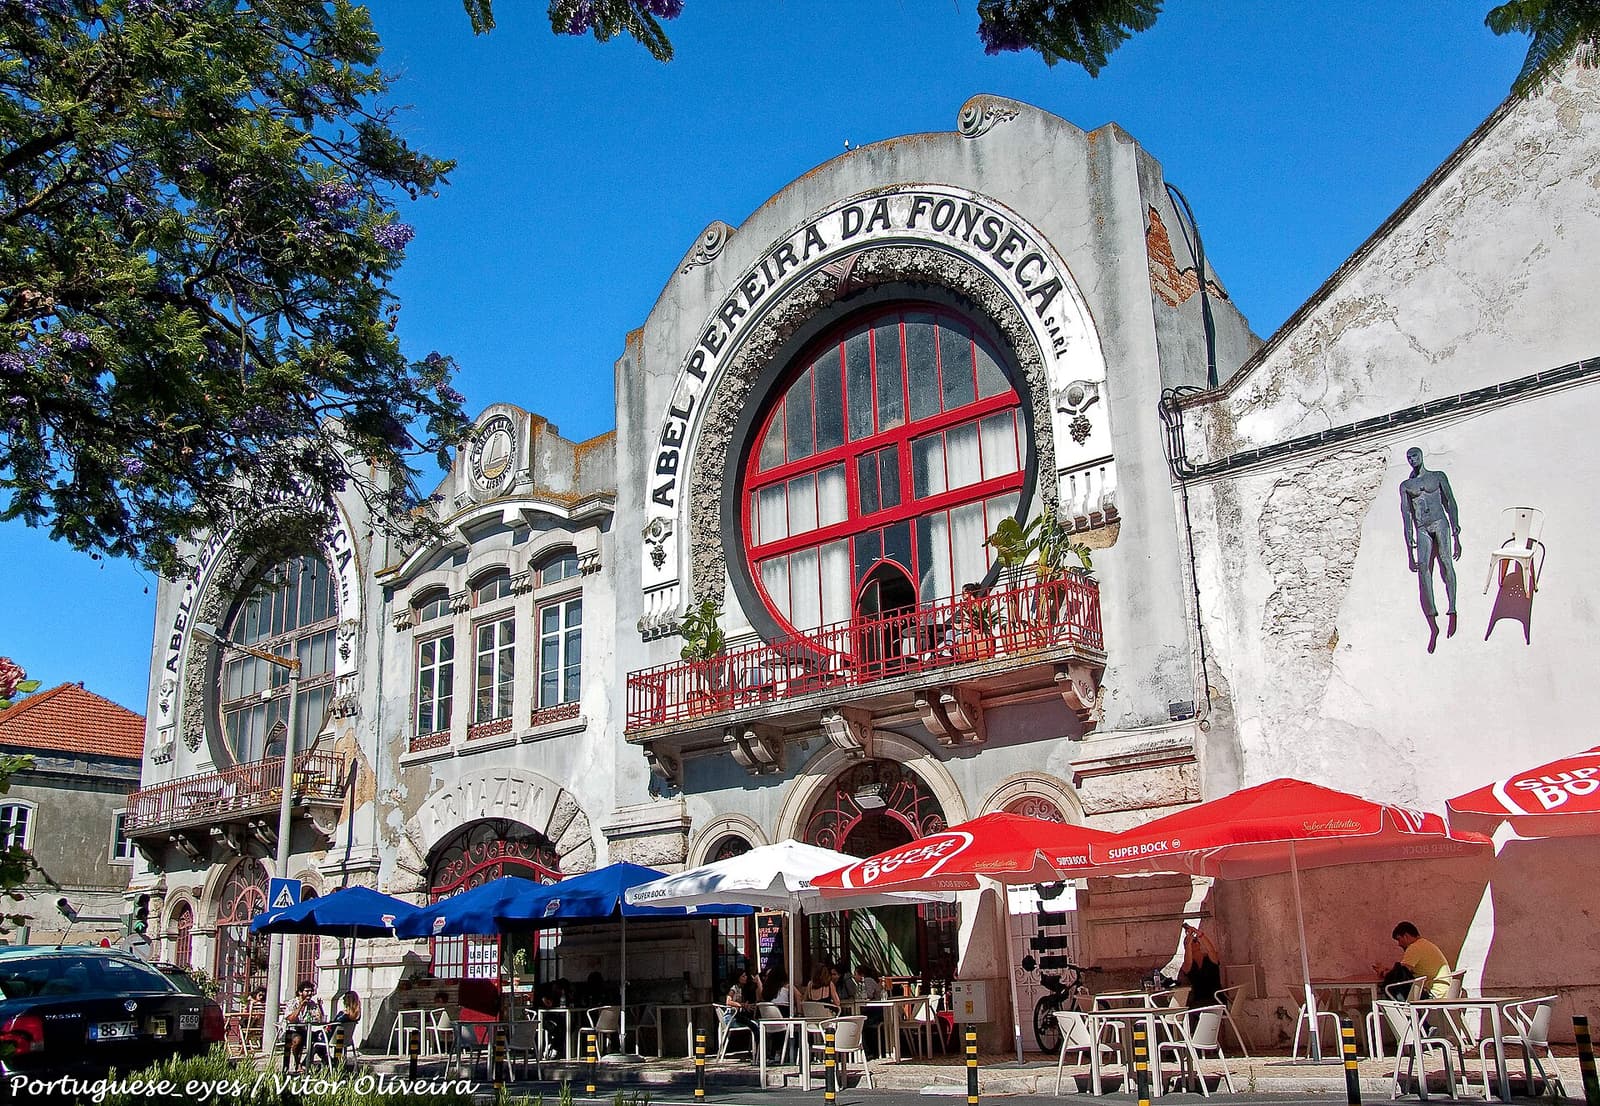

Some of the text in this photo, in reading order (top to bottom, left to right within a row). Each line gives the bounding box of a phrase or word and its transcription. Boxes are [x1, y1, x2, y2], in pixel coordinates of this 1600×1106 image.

[652, 394, 695, 508] ABEL
[686, 213, 827, 383] PEREIRA
[841, 198, 891, 240] DA
[906, 195, 1064, 319] FONSECA
[166, 596, 193, 674] ABEL
[1513, 765, 1600, 790] SUP
[862, 838, 957, 869] SUPER
[1108, 840, 1168, 859] SUPER BOCK
[633, 891, 651, 901] SUPER
[469, 950, 497, 959] UBER
[469, 964, 497, 975] EATS
[45, 1011, 82, 1020] PASSAT
